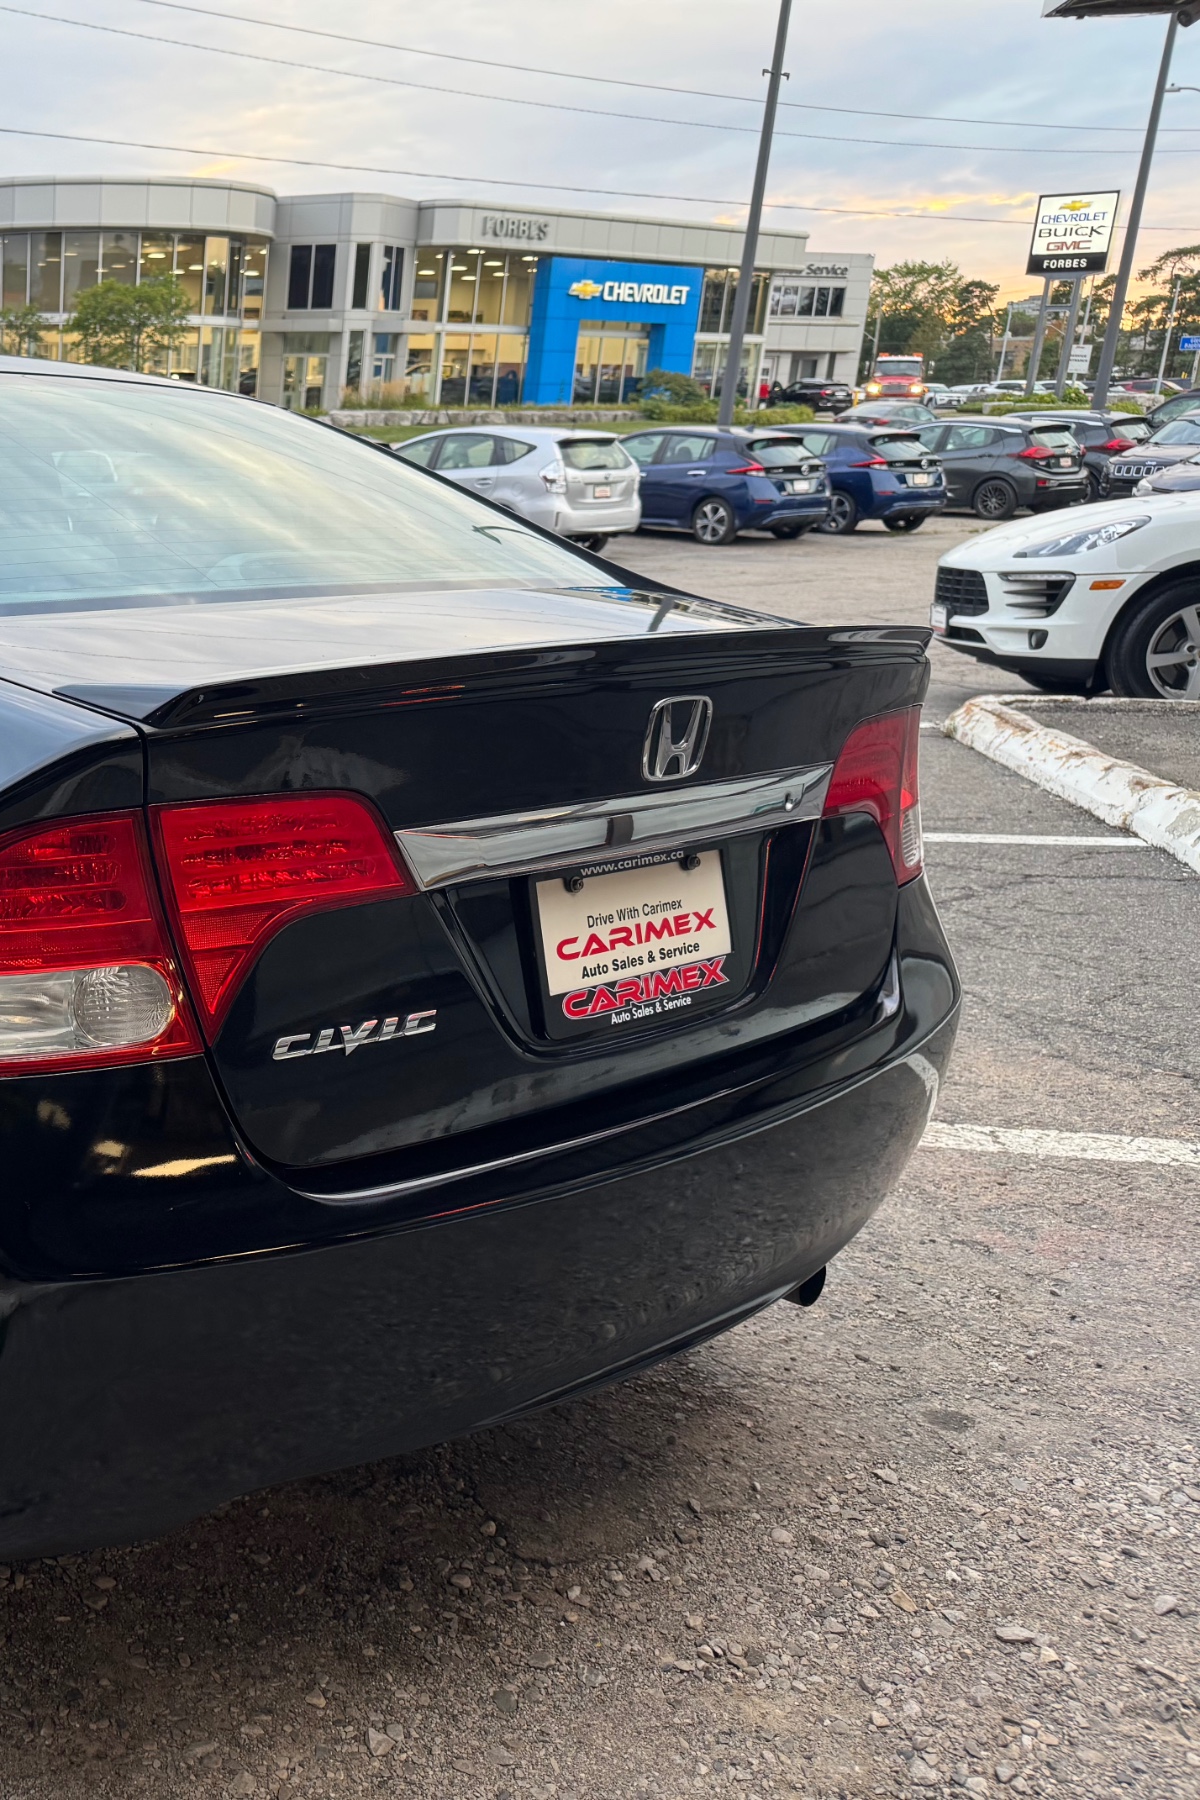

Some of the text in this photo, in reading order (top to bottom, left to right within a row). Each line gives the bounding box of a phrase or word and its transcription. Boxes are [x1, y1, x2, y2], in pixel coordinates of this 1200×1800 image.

[481, 216, 549, 241] FORBES
[1041, 212, 1108, 224] CHEVROLET
[1038, 225, 1109, 238] BUICK
[1046, 240, 1092, 251] GMC
[806, 263, 848, 276] Service
[1043, 258, 1087, 269] FORBES
[603, 281, 690, 305] CHEVROLET
[580, 850, 684, 876] www.carimex.ca
[587, 899, 682, 928] Drive With Carimex
[556, 908, 717, 961] CARIMEX
[582, 941, 700, 979] Auto Sales & Service
[563, 956, 729, 1019] CARIMEX
[611, 995, 692, 1025] Auto Sales & Service
[272, 1009, 437, 1061] CIVIC
